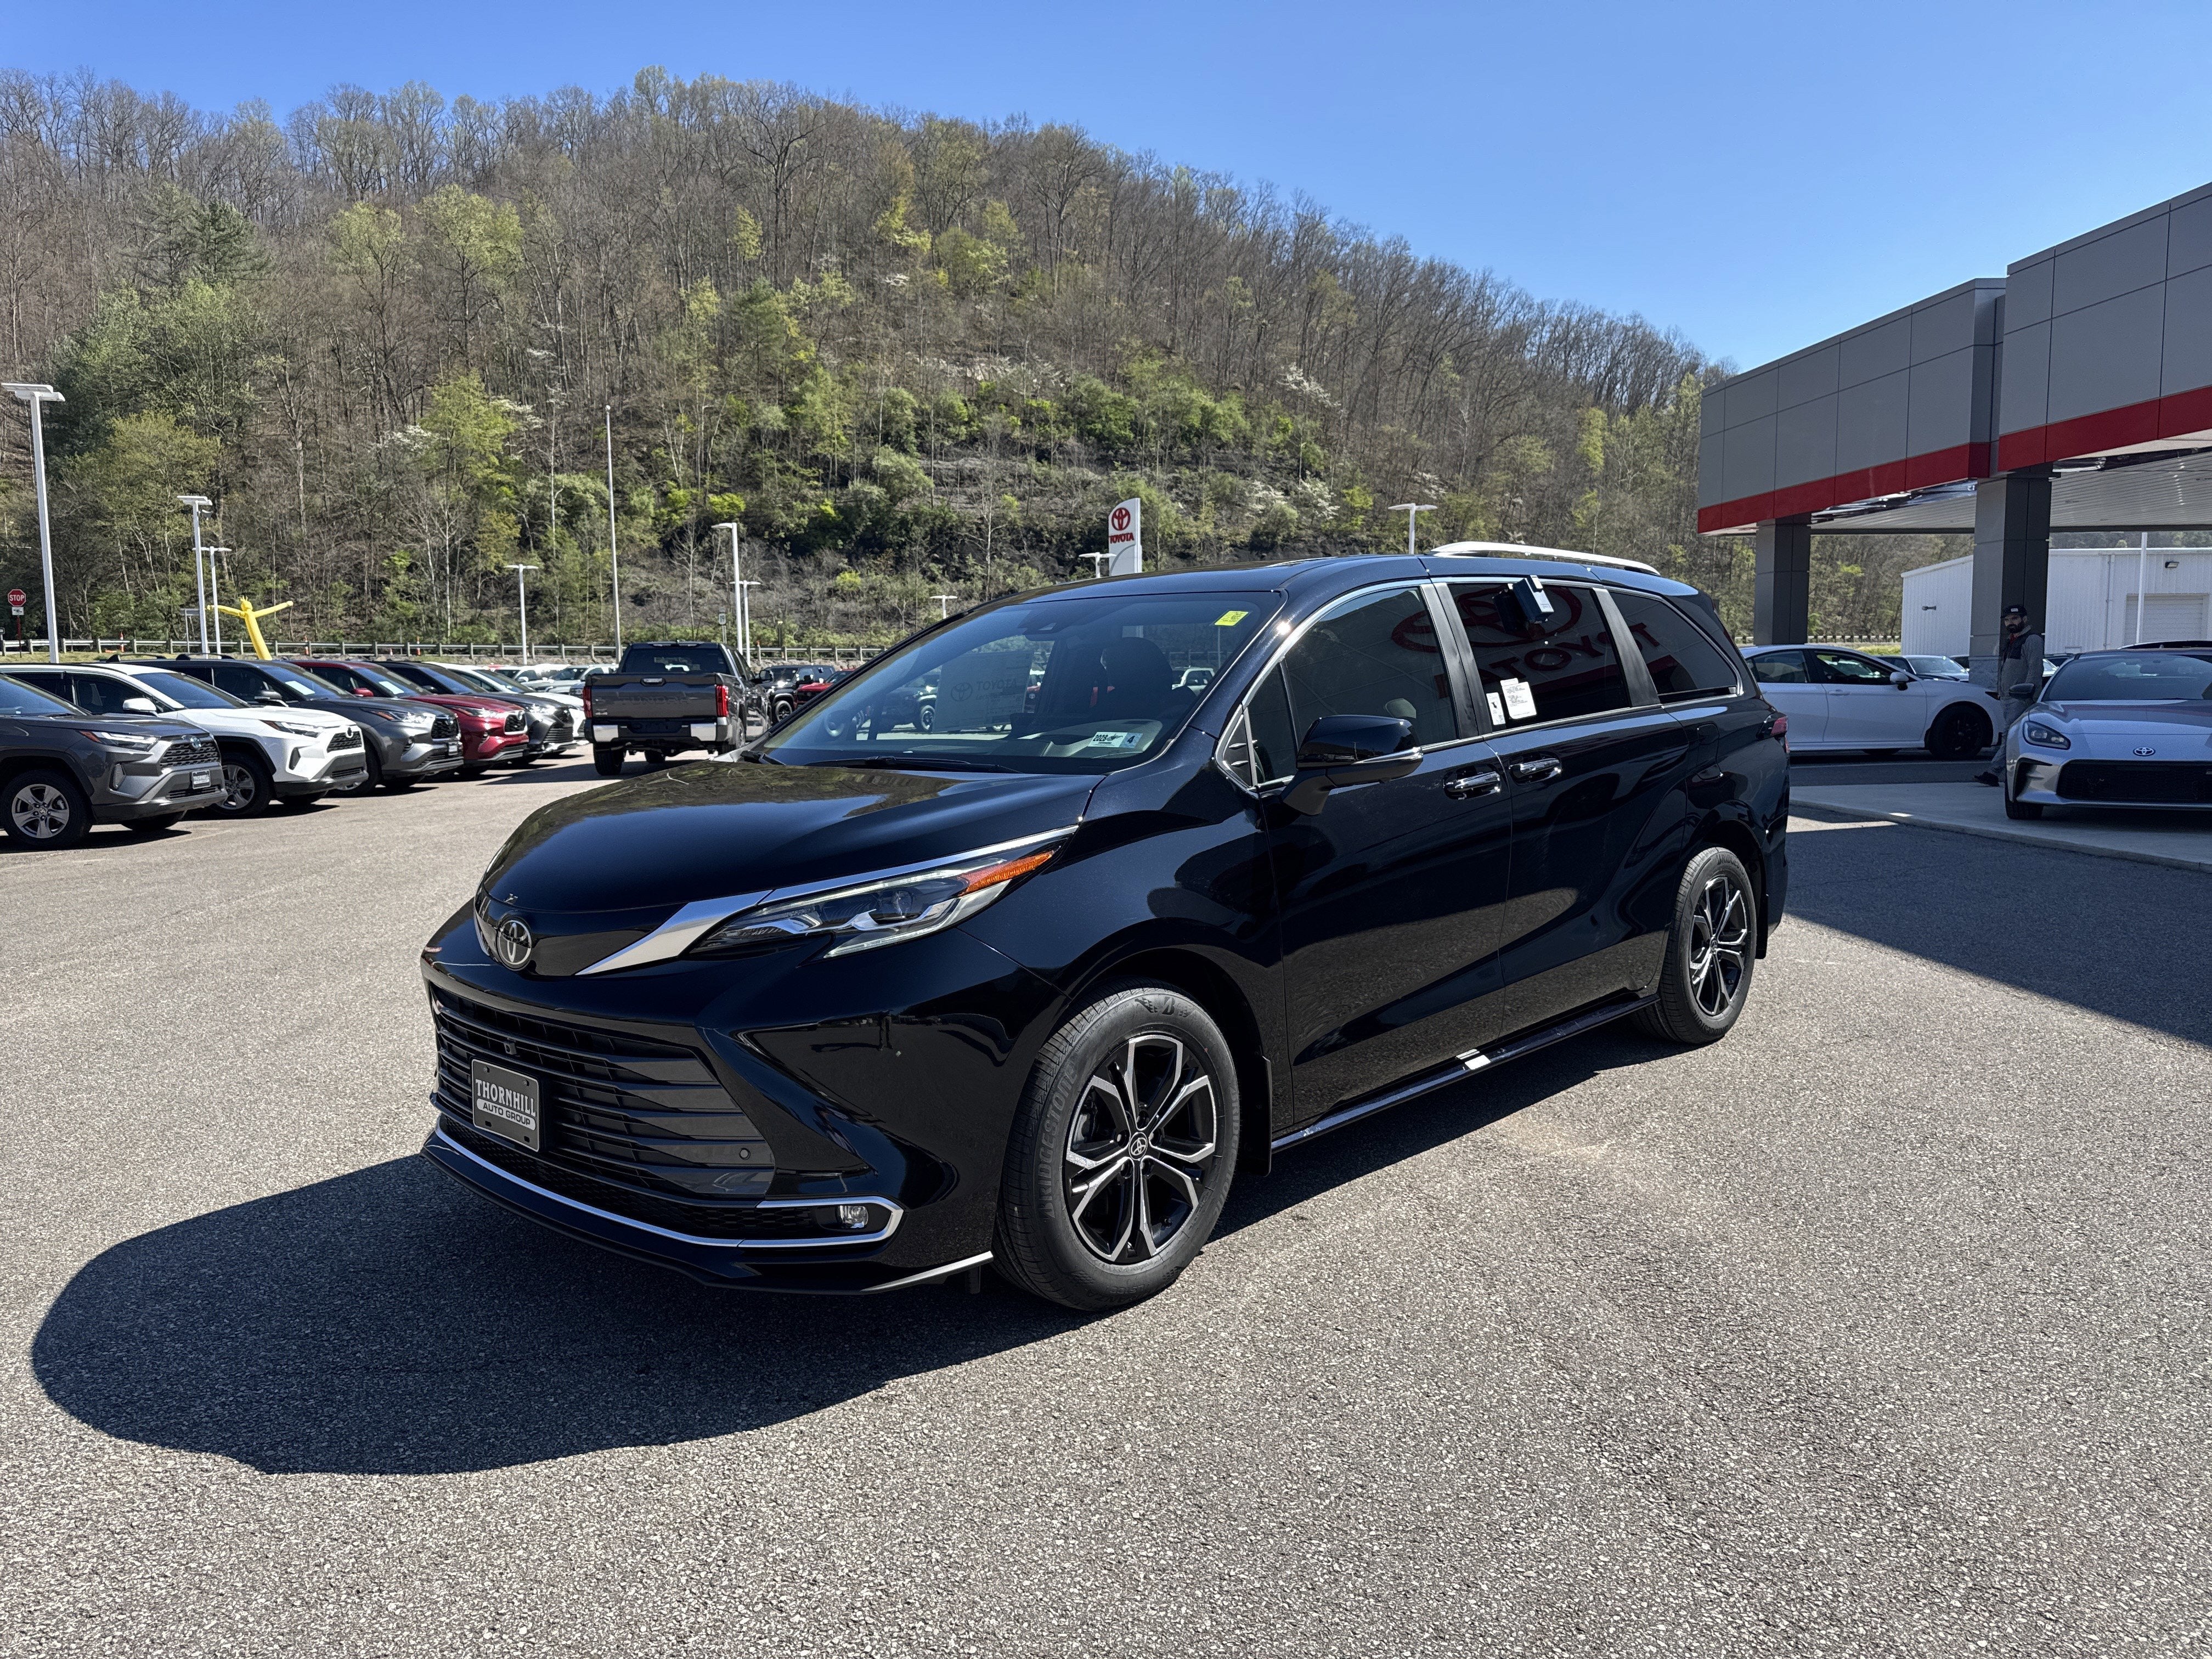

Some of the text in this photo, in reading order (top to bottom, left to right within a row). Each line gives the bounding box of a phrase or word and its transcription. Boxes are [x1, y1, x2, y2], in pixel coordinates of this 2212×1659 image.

[1108, 533, 1134, 544] TOYOTA
[976, 679, 1017, 691] TOYOTA
[475, 1079, 536, 1117] THORNHILL
[483, 1103, 531, 1126] AUTO GROUP
[1038, 1063, 1077, 1218] BRIDGESTONE
